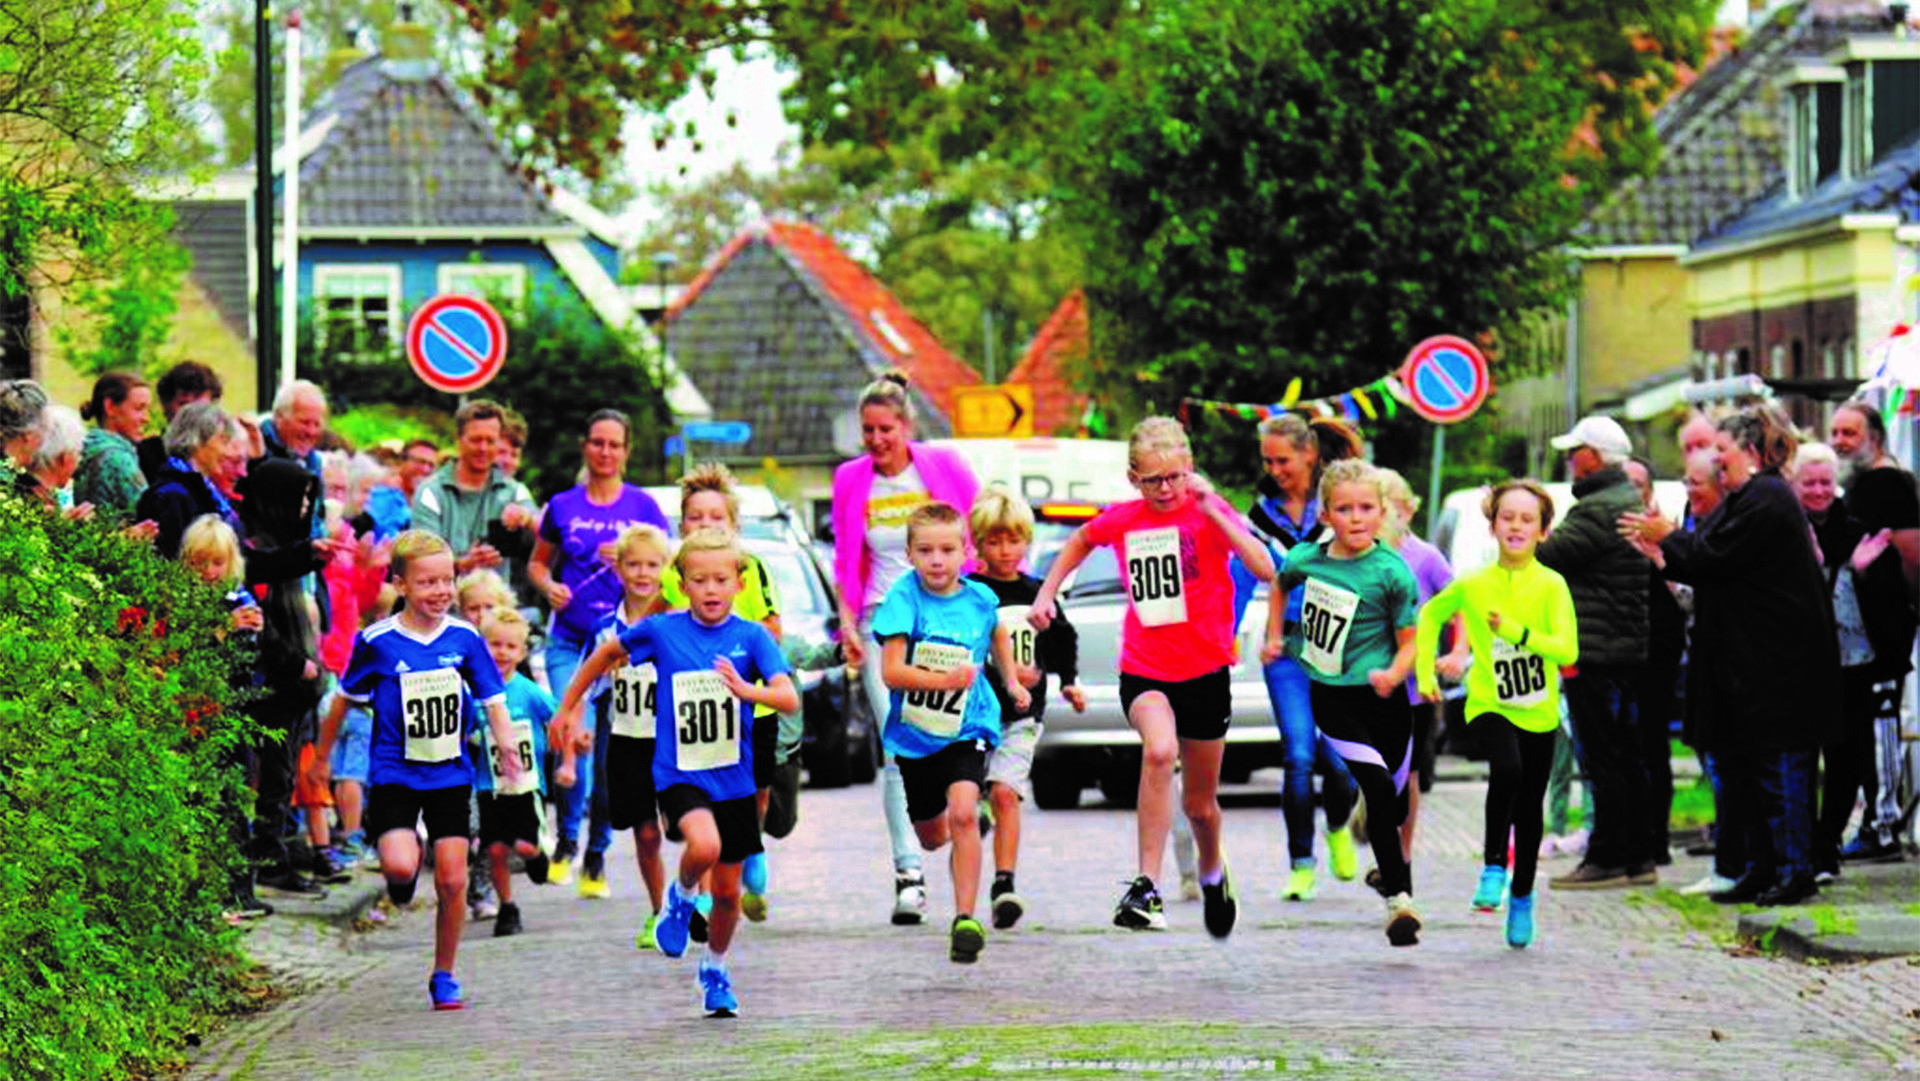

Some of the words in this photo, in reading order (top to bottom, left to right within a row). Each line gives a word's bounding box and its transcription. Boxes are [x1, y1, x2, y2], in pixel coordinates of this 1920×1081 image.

[1129, 553, 1180, 602] 309
[1010, 629, 1032, 667] 16
[1304, 602, 1347, 654] 307
[615, 679, 657, 716] 314
[1494, 654, 1545, 699] 303
[407, 693, 459, 739] 308
[679, 697, 734, 744] 301
[490, 740, 532, 777] 36
